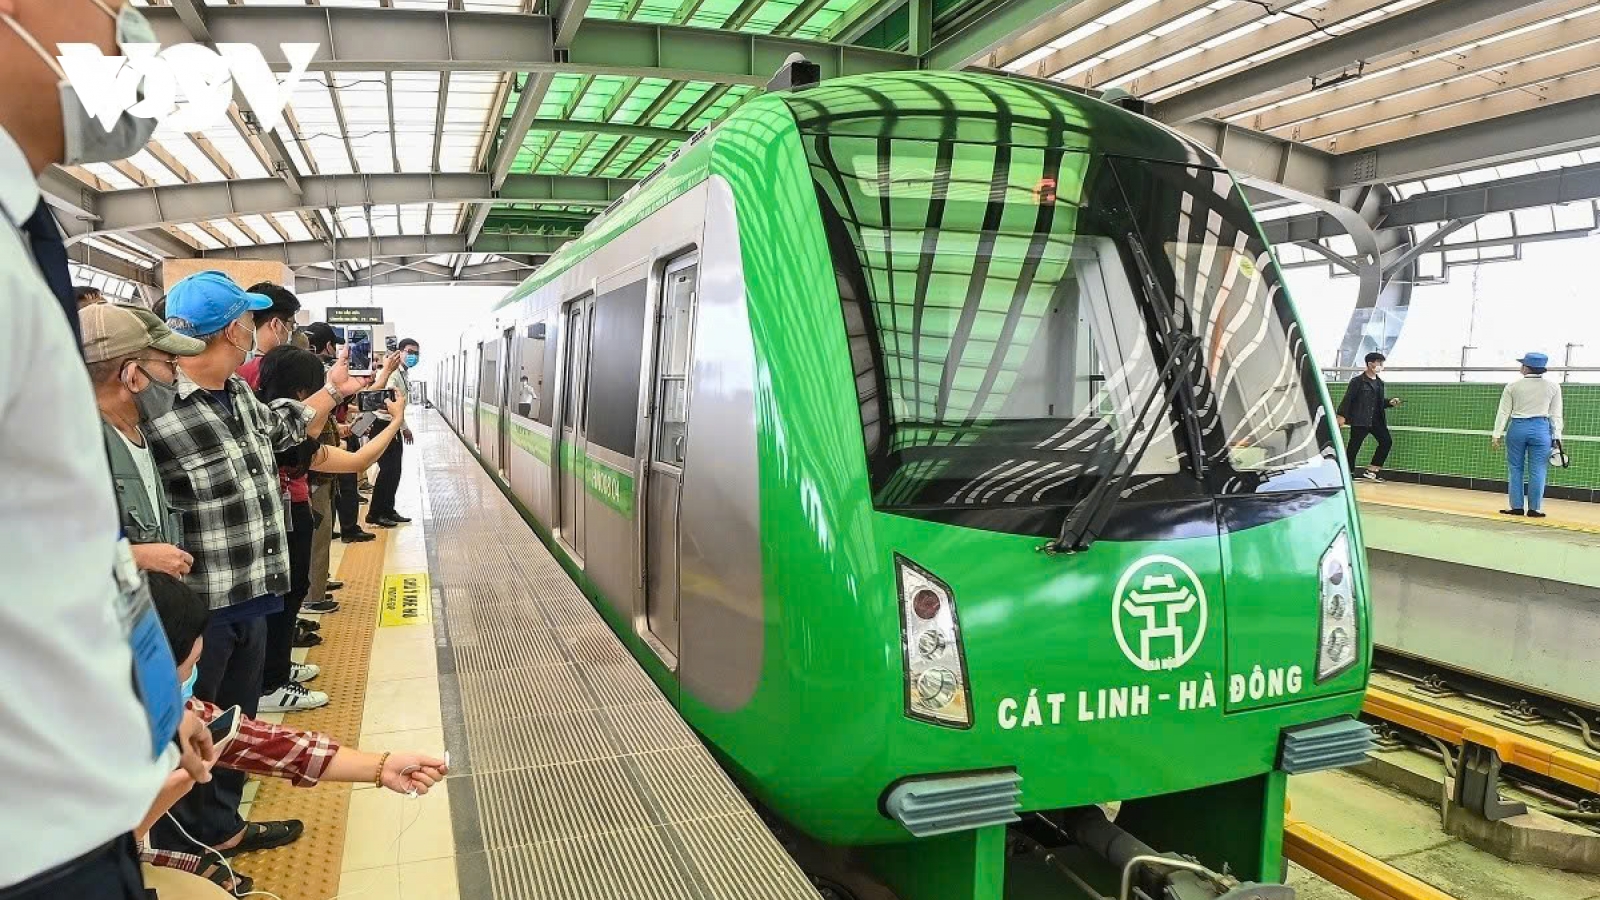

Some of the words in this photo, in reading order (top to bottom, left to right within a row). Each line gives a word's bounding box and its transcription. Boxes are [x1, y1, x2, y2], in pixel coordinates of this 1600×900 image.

[997, 688, 1066, 730] CÁT
[1078, 685, 1149, 722] LINH
[1178, 672, 1217, 711] HÀ
[1228, 664, 1302, 703] ĐÔNG
